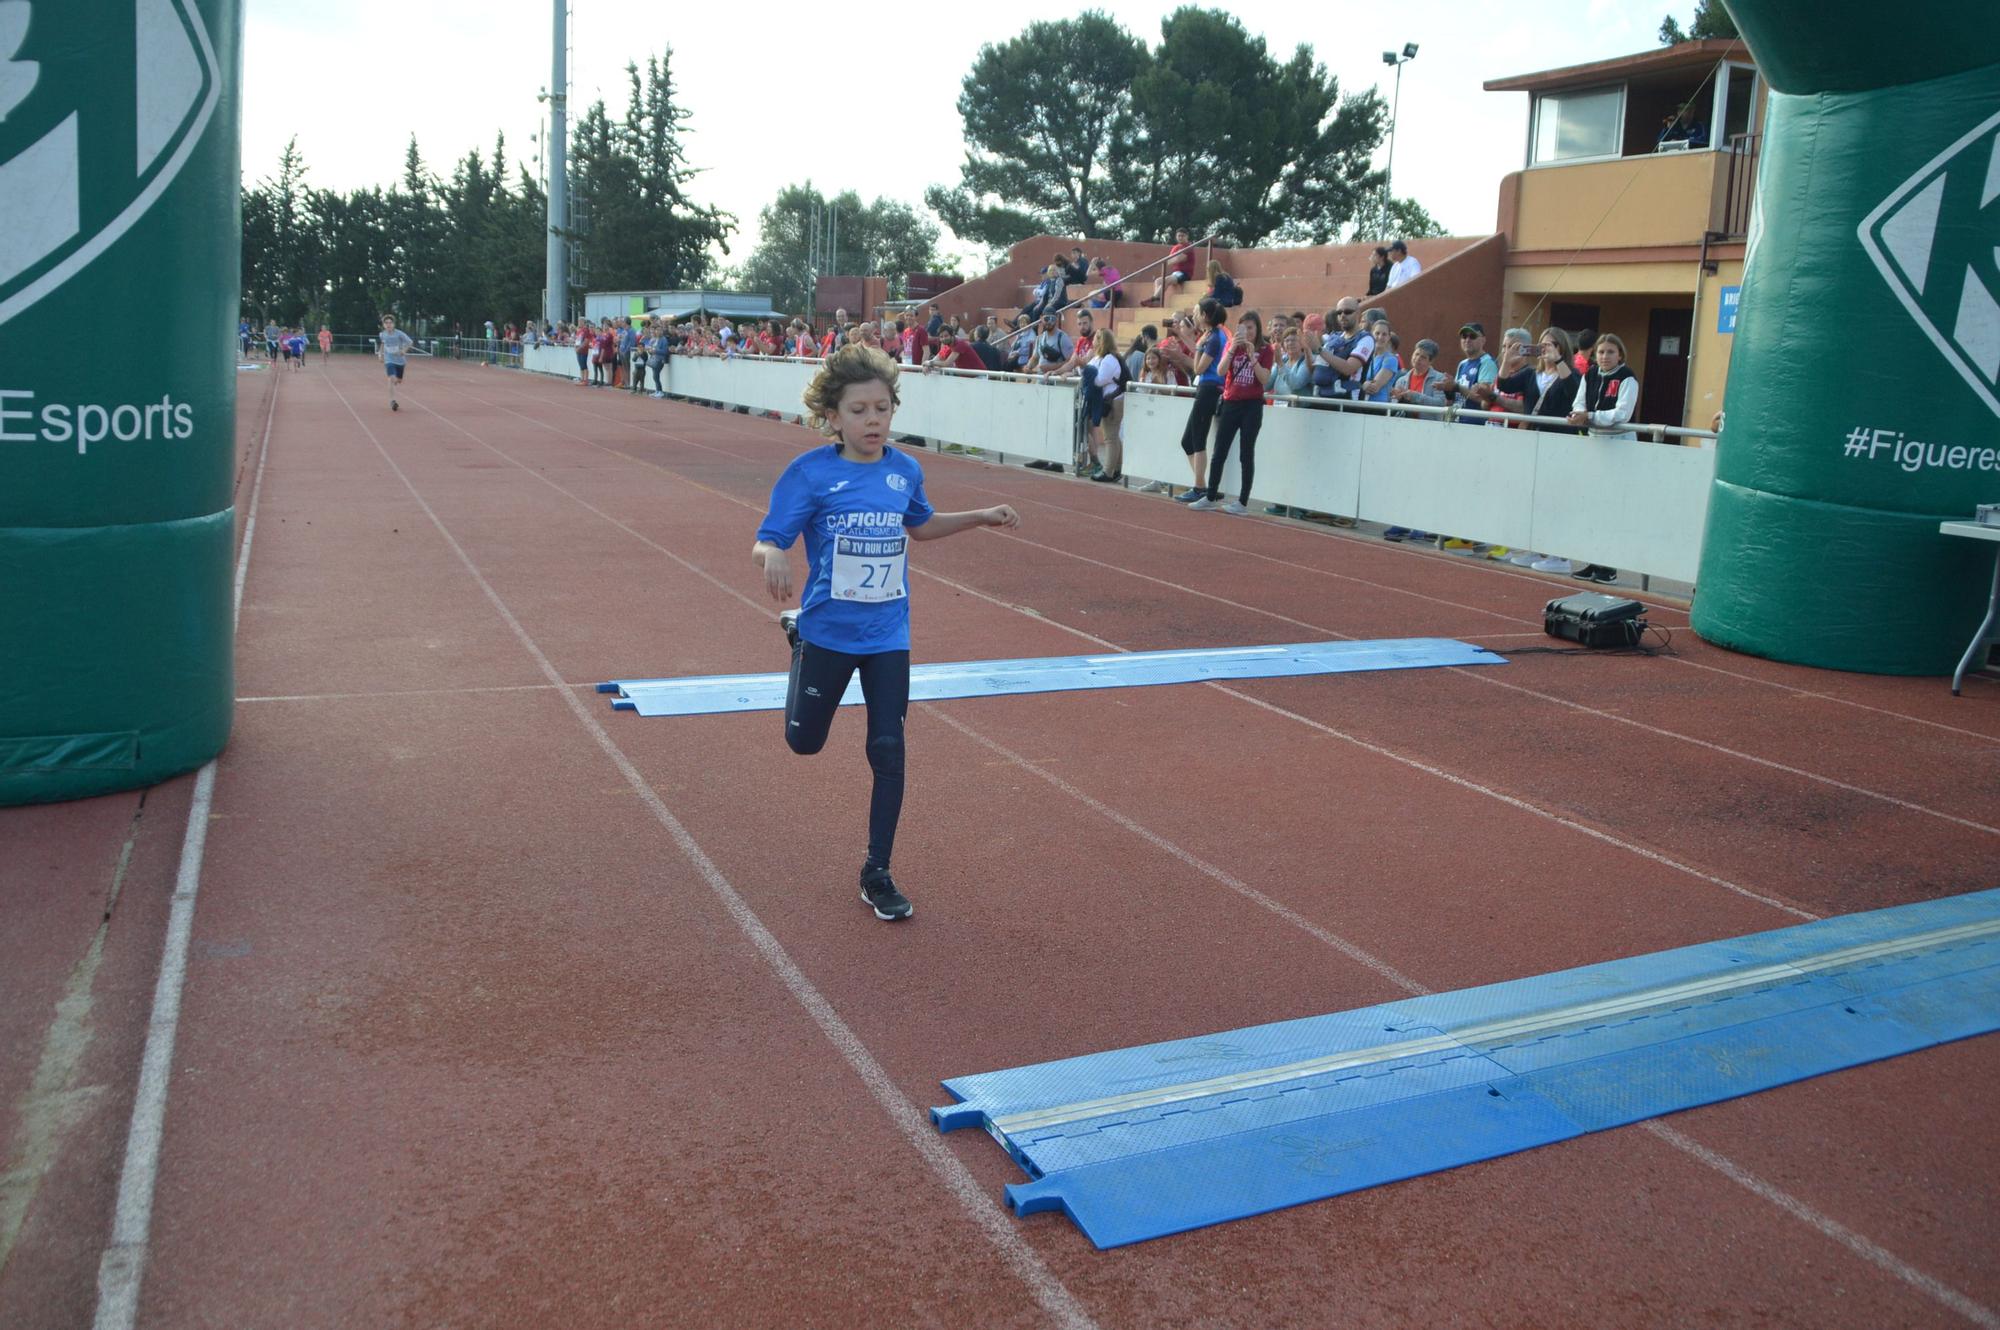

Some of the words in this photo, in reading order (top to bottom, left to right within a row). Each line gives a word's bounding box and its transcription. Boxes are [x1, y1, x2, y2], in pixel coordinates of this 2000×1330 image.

[0, 389, 194, 454] Esports
[852, 542, 863, 553] XV
[864, 542, 882, 554] RUN
[859, 564, 893, 589] 27
